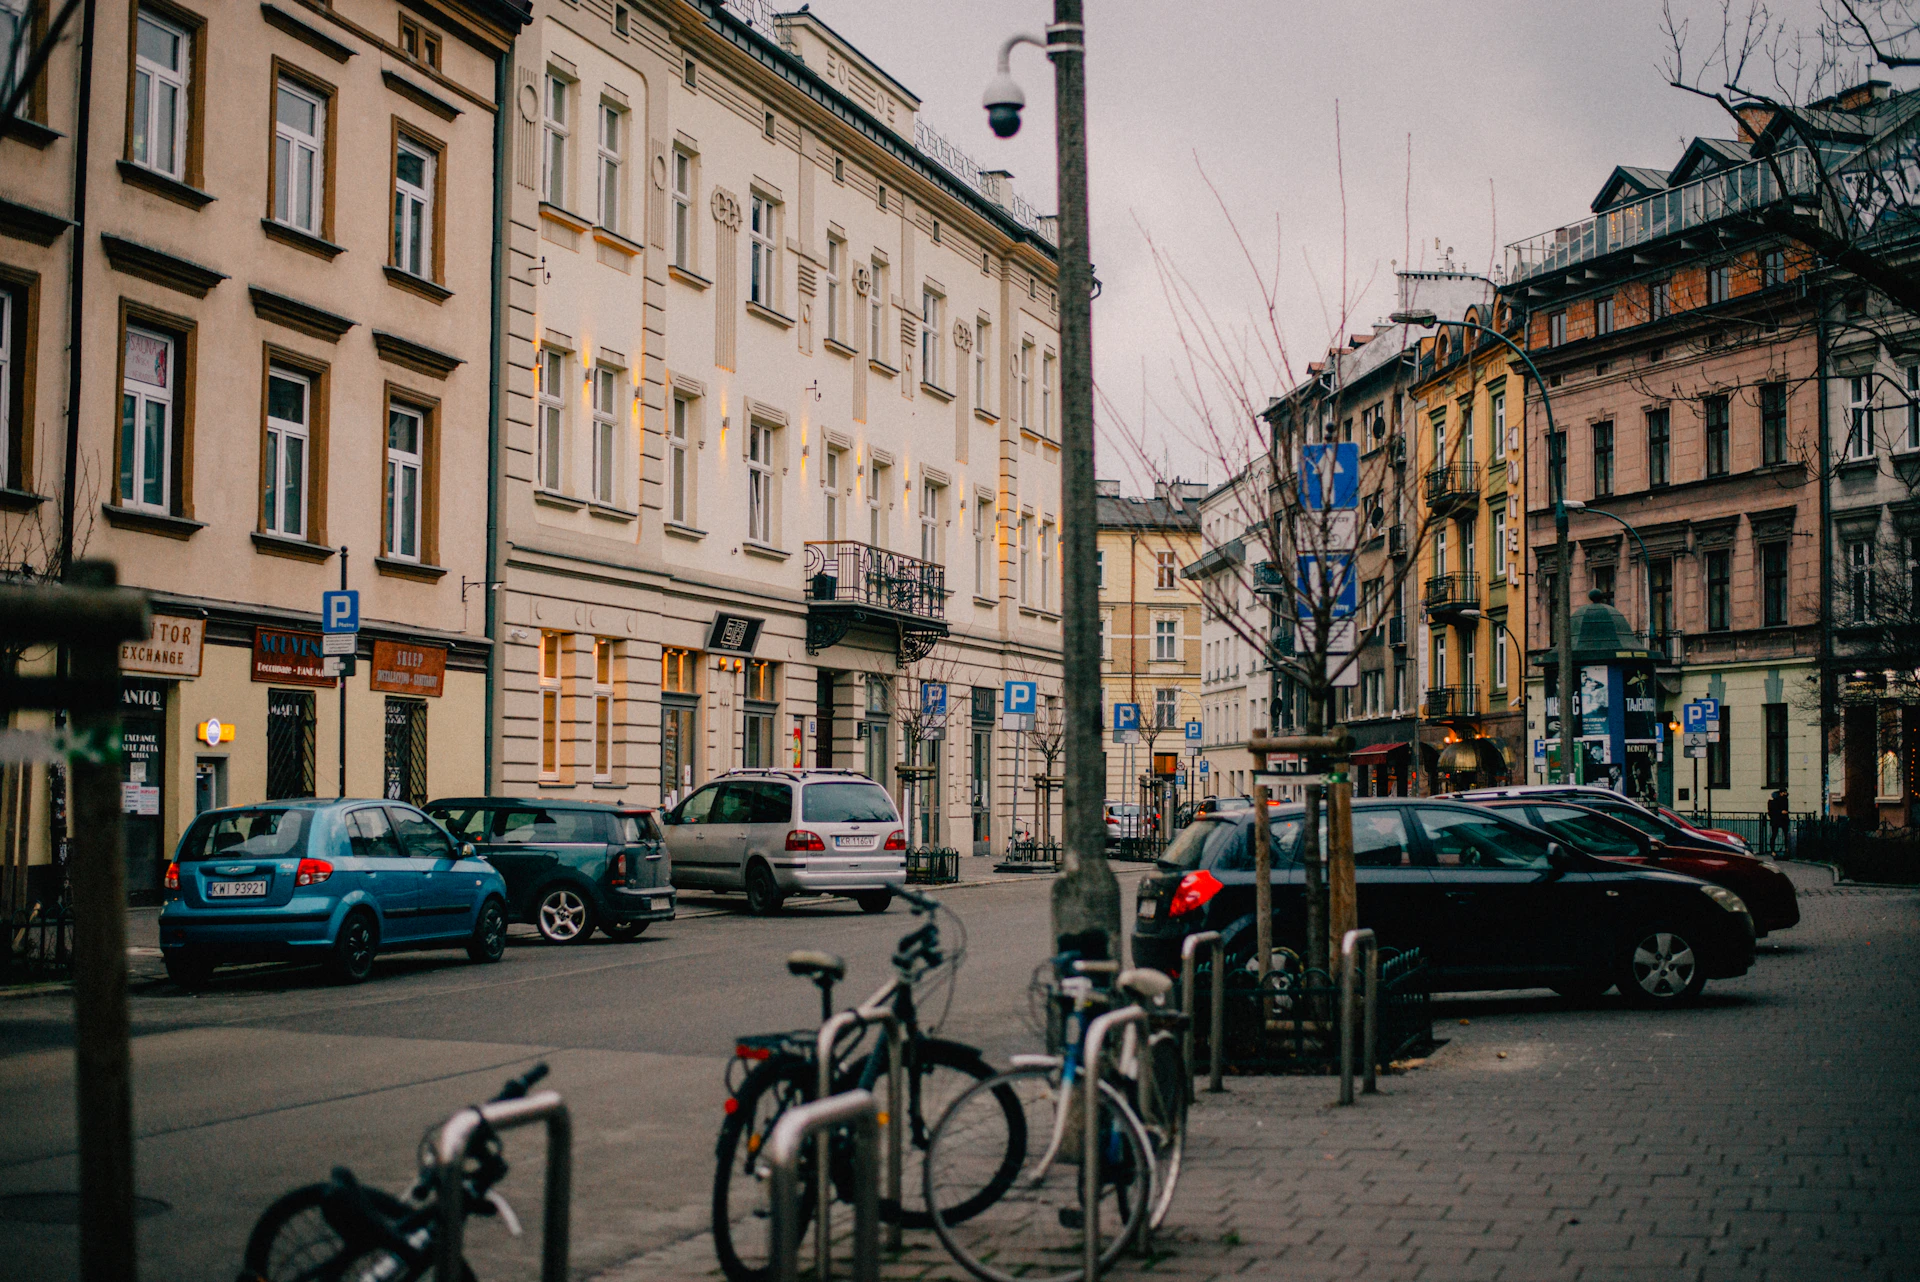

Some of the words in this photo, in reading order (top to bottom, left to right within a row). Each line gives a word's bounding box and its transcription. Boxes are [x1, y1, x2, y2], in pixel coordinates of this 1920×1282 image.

[1508, 426, 1519, 586] HOTEL
[331, 596, 350, 628] P
[122, 646, 184, 665] EXCHANGE
[262, 634, 324, 658] SOUVEN
[397, 651, 423, 667] SKLEP
[122, 689, 161, 705] ANTOR
[928, 686, 942, 705] P
[1010, 684, 1029, 710] P
[1547, 691, 1580, 716] MIŁĆ
[1119, 706, 1135, 727] P
[1689, 706, 1702, 724] P
[1189, 724, 1198, 737] P
[1537, 741, 1545, 752] P
[213, 883, 230, 894] KWI
[235, 883, 264, 894] 93921
